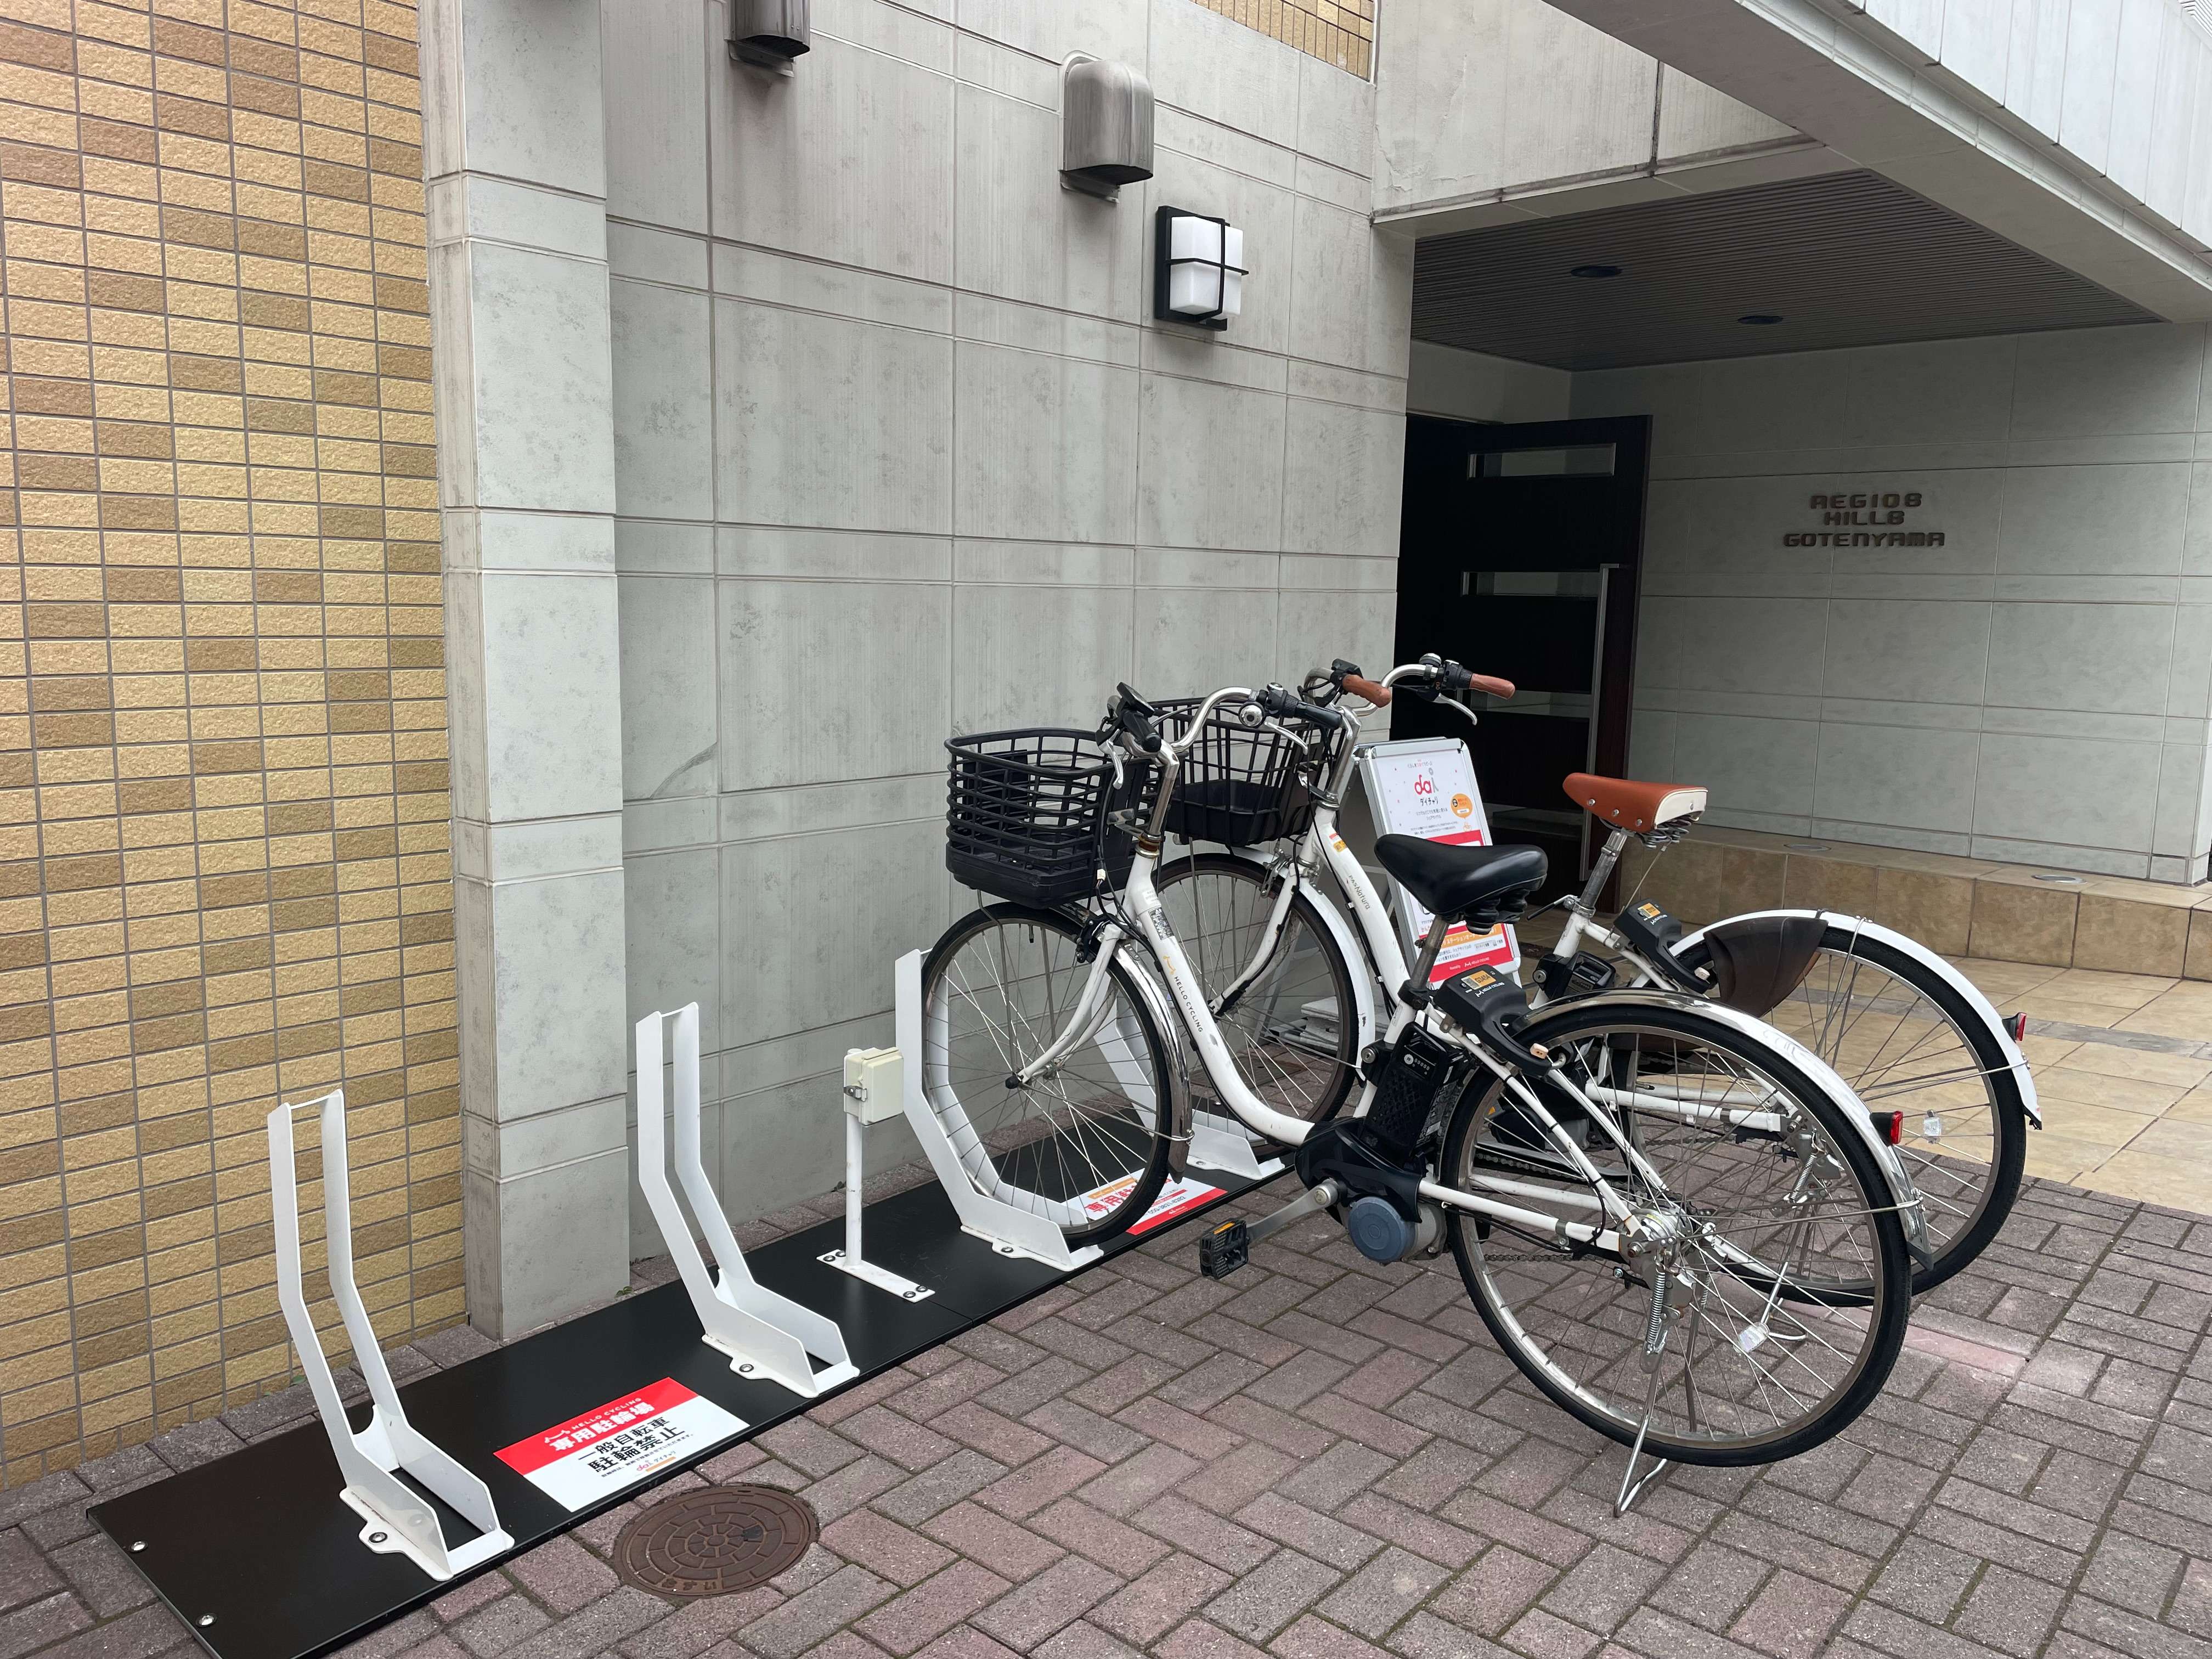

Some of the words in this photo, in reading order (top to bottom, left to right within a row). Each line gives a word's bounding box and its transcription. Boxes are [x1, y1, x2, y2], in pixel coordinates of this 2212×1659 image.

[1784, 532, 1945, 547] GOTENYAMA
[1174, 976, 1188, 1000] HELLO
[1186, 1002, 1203, 1032] CYCLING
[572, 1415, 602, 1430] HELLO
[604, 1398, 642, 1415] CYCLING
[578, 1416, 670, 1460] 一般自転車
[588, 1426, 685, 1472] 駐輪禁止
